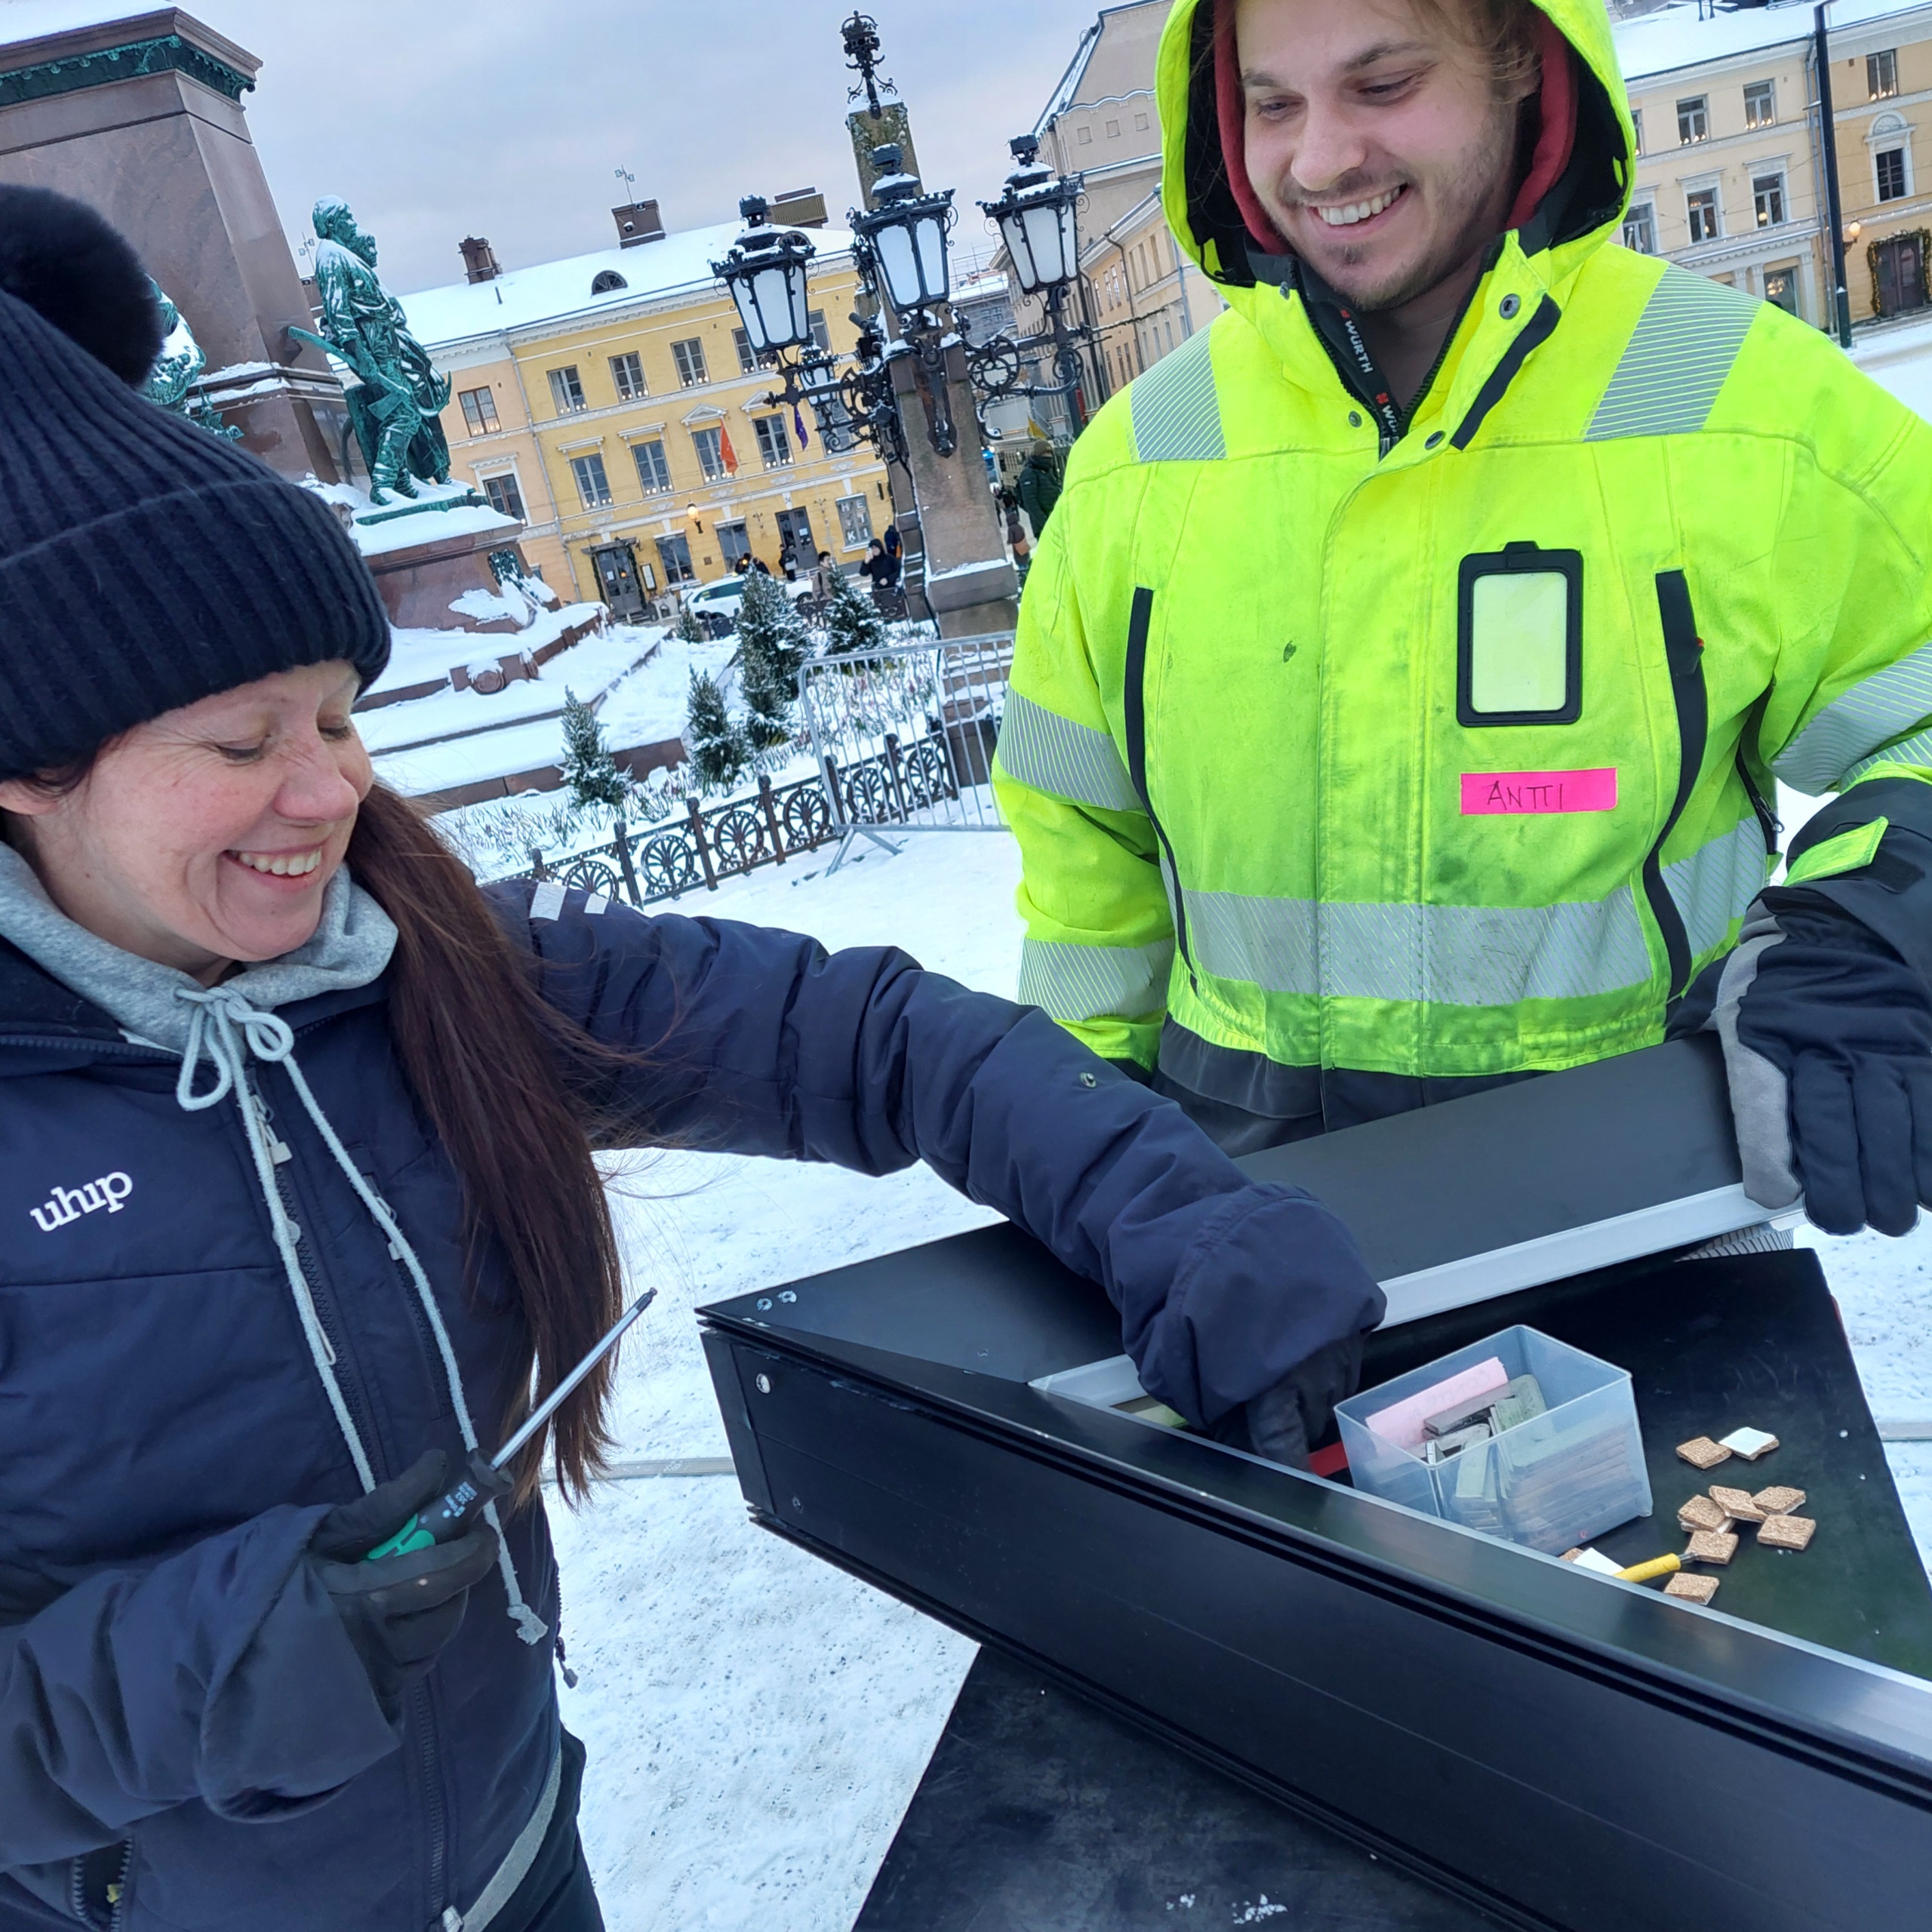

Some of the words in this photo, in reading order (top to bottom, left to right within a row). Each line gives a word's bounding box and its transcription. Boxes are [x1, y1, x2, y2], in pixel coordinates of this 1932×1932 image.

[1344, 320, 1374, 374] WÜRTH
[1487, 780, 1563, 811] ANTTI
[29, 1171, 134, 1232] uhip
